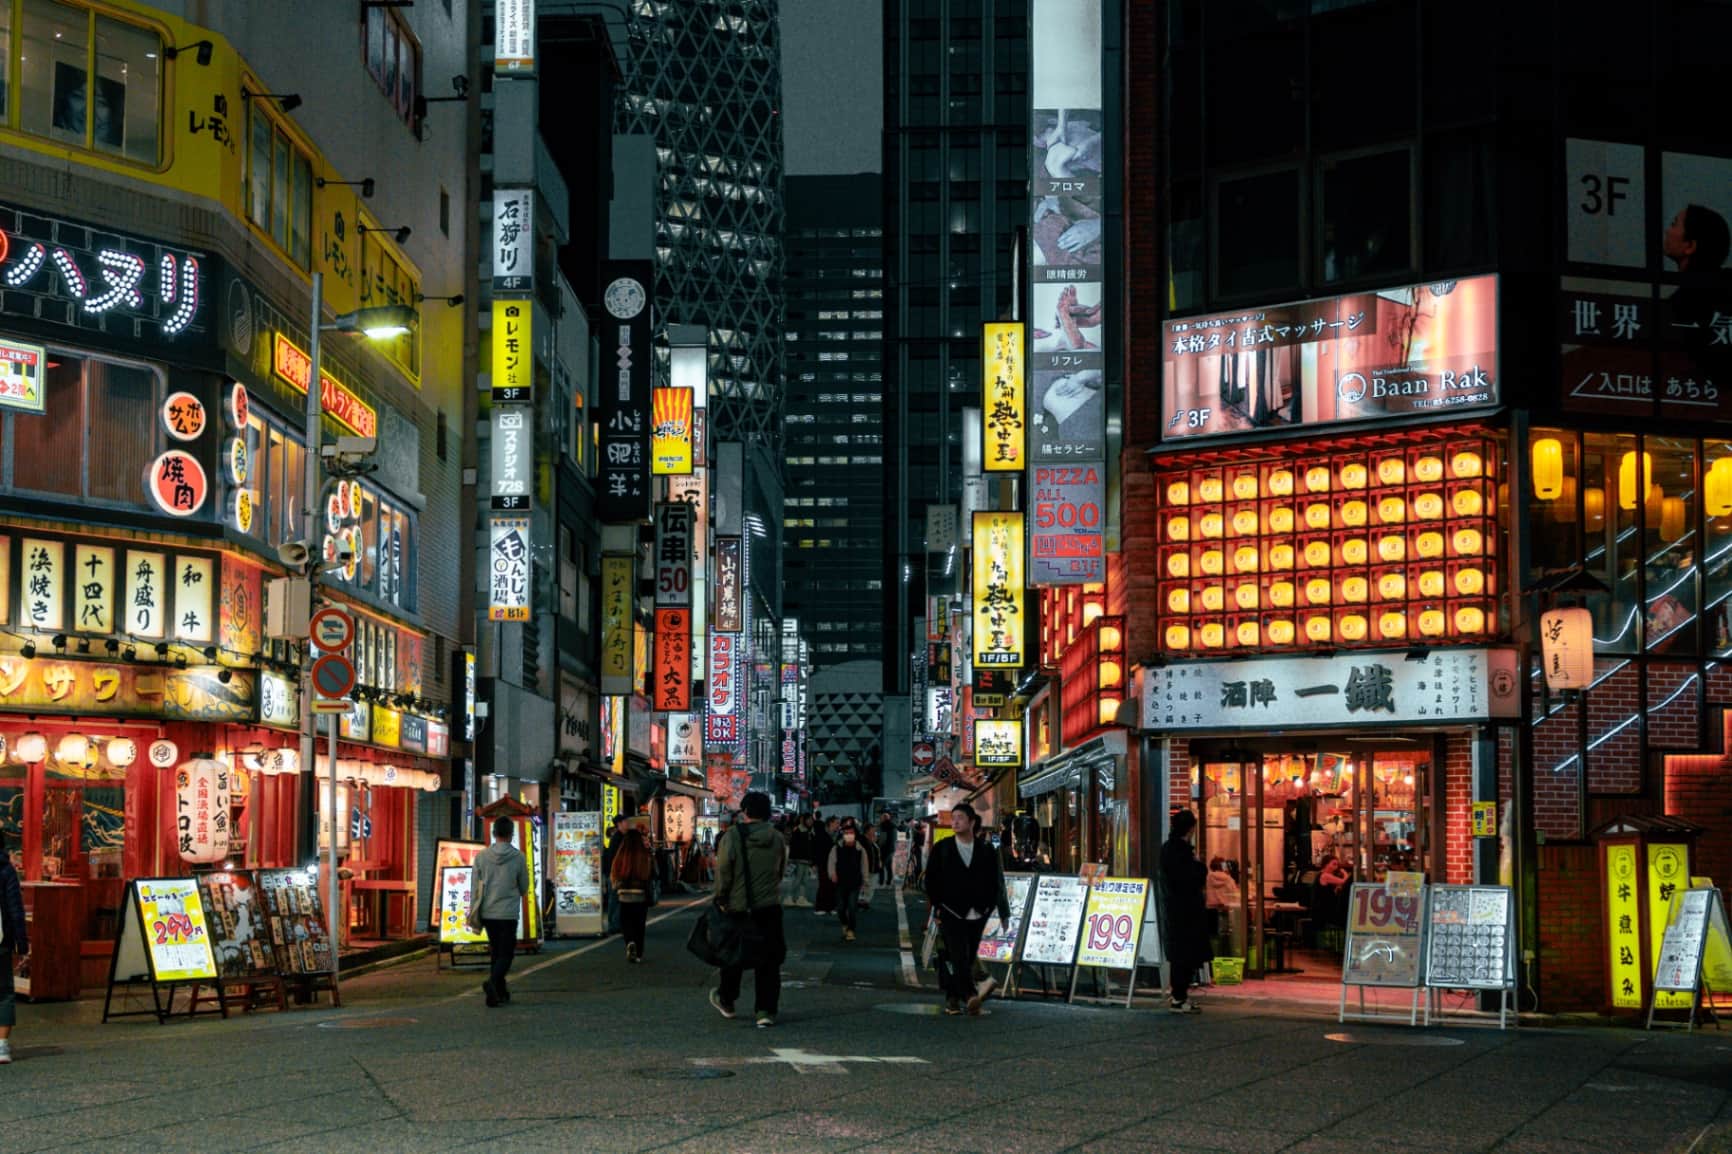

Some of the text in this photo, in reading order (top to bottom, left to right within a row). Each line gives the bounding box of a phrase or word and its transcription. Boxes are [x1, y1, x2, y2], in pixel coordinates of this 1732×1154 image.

[1049, 181, 1085, 191] アロマ
[1580, 174, 1630, 216] 3F
[498, 200, 521, 271] 石狩川
[7, 242, 199, 336] ハヌリ
[503, 277, 521, 288] 4F
[1046, 268, 1087, 280] 眼精疲労
[1173, 311, 1365, 355] 本格タイ古式マッサージ
[1050, 355, 1083, 366] リフレ
[1371, 365, 1488, 398] Baan Rak
[503, 388, 519, 398] 3F
[1597, 372, 1719, 400] 入口はあちら
[1187, 409, 1212, 428] 3F
[497, 431, 524, 493] スタジオ 728
[607, 409, 633, 497] 小肥羊
[1041, 444, 1096, 455] 腸セラピー
[162, 457, 194, 510] 焼肉
[1035, 468, 1099, 486] PIZZA
[503, 497, 518, 507] 3F
[1036, 502, 1100, 528] 500
[662, 505, 687, 563] 伝串
[30, 547, 53, 622] 浜焼き
[82, 553, 105, 628] 十四代
[133, 559, 155, 631] 舟盛り
[182, 563, 203, 633] 和牛
[663, 666, 682, 708] 大黒
[712, 635, 731, 706] カラオケ
[1452, 656, 1460, 714] レモンサワー
[1468, 655, 1479, 713] アサヒビール
[1220, 678, 1278, 710] 酒陣
[711, 729, 732, 738] OK
[1617, 882, 1634, 996] 牛煮込み
